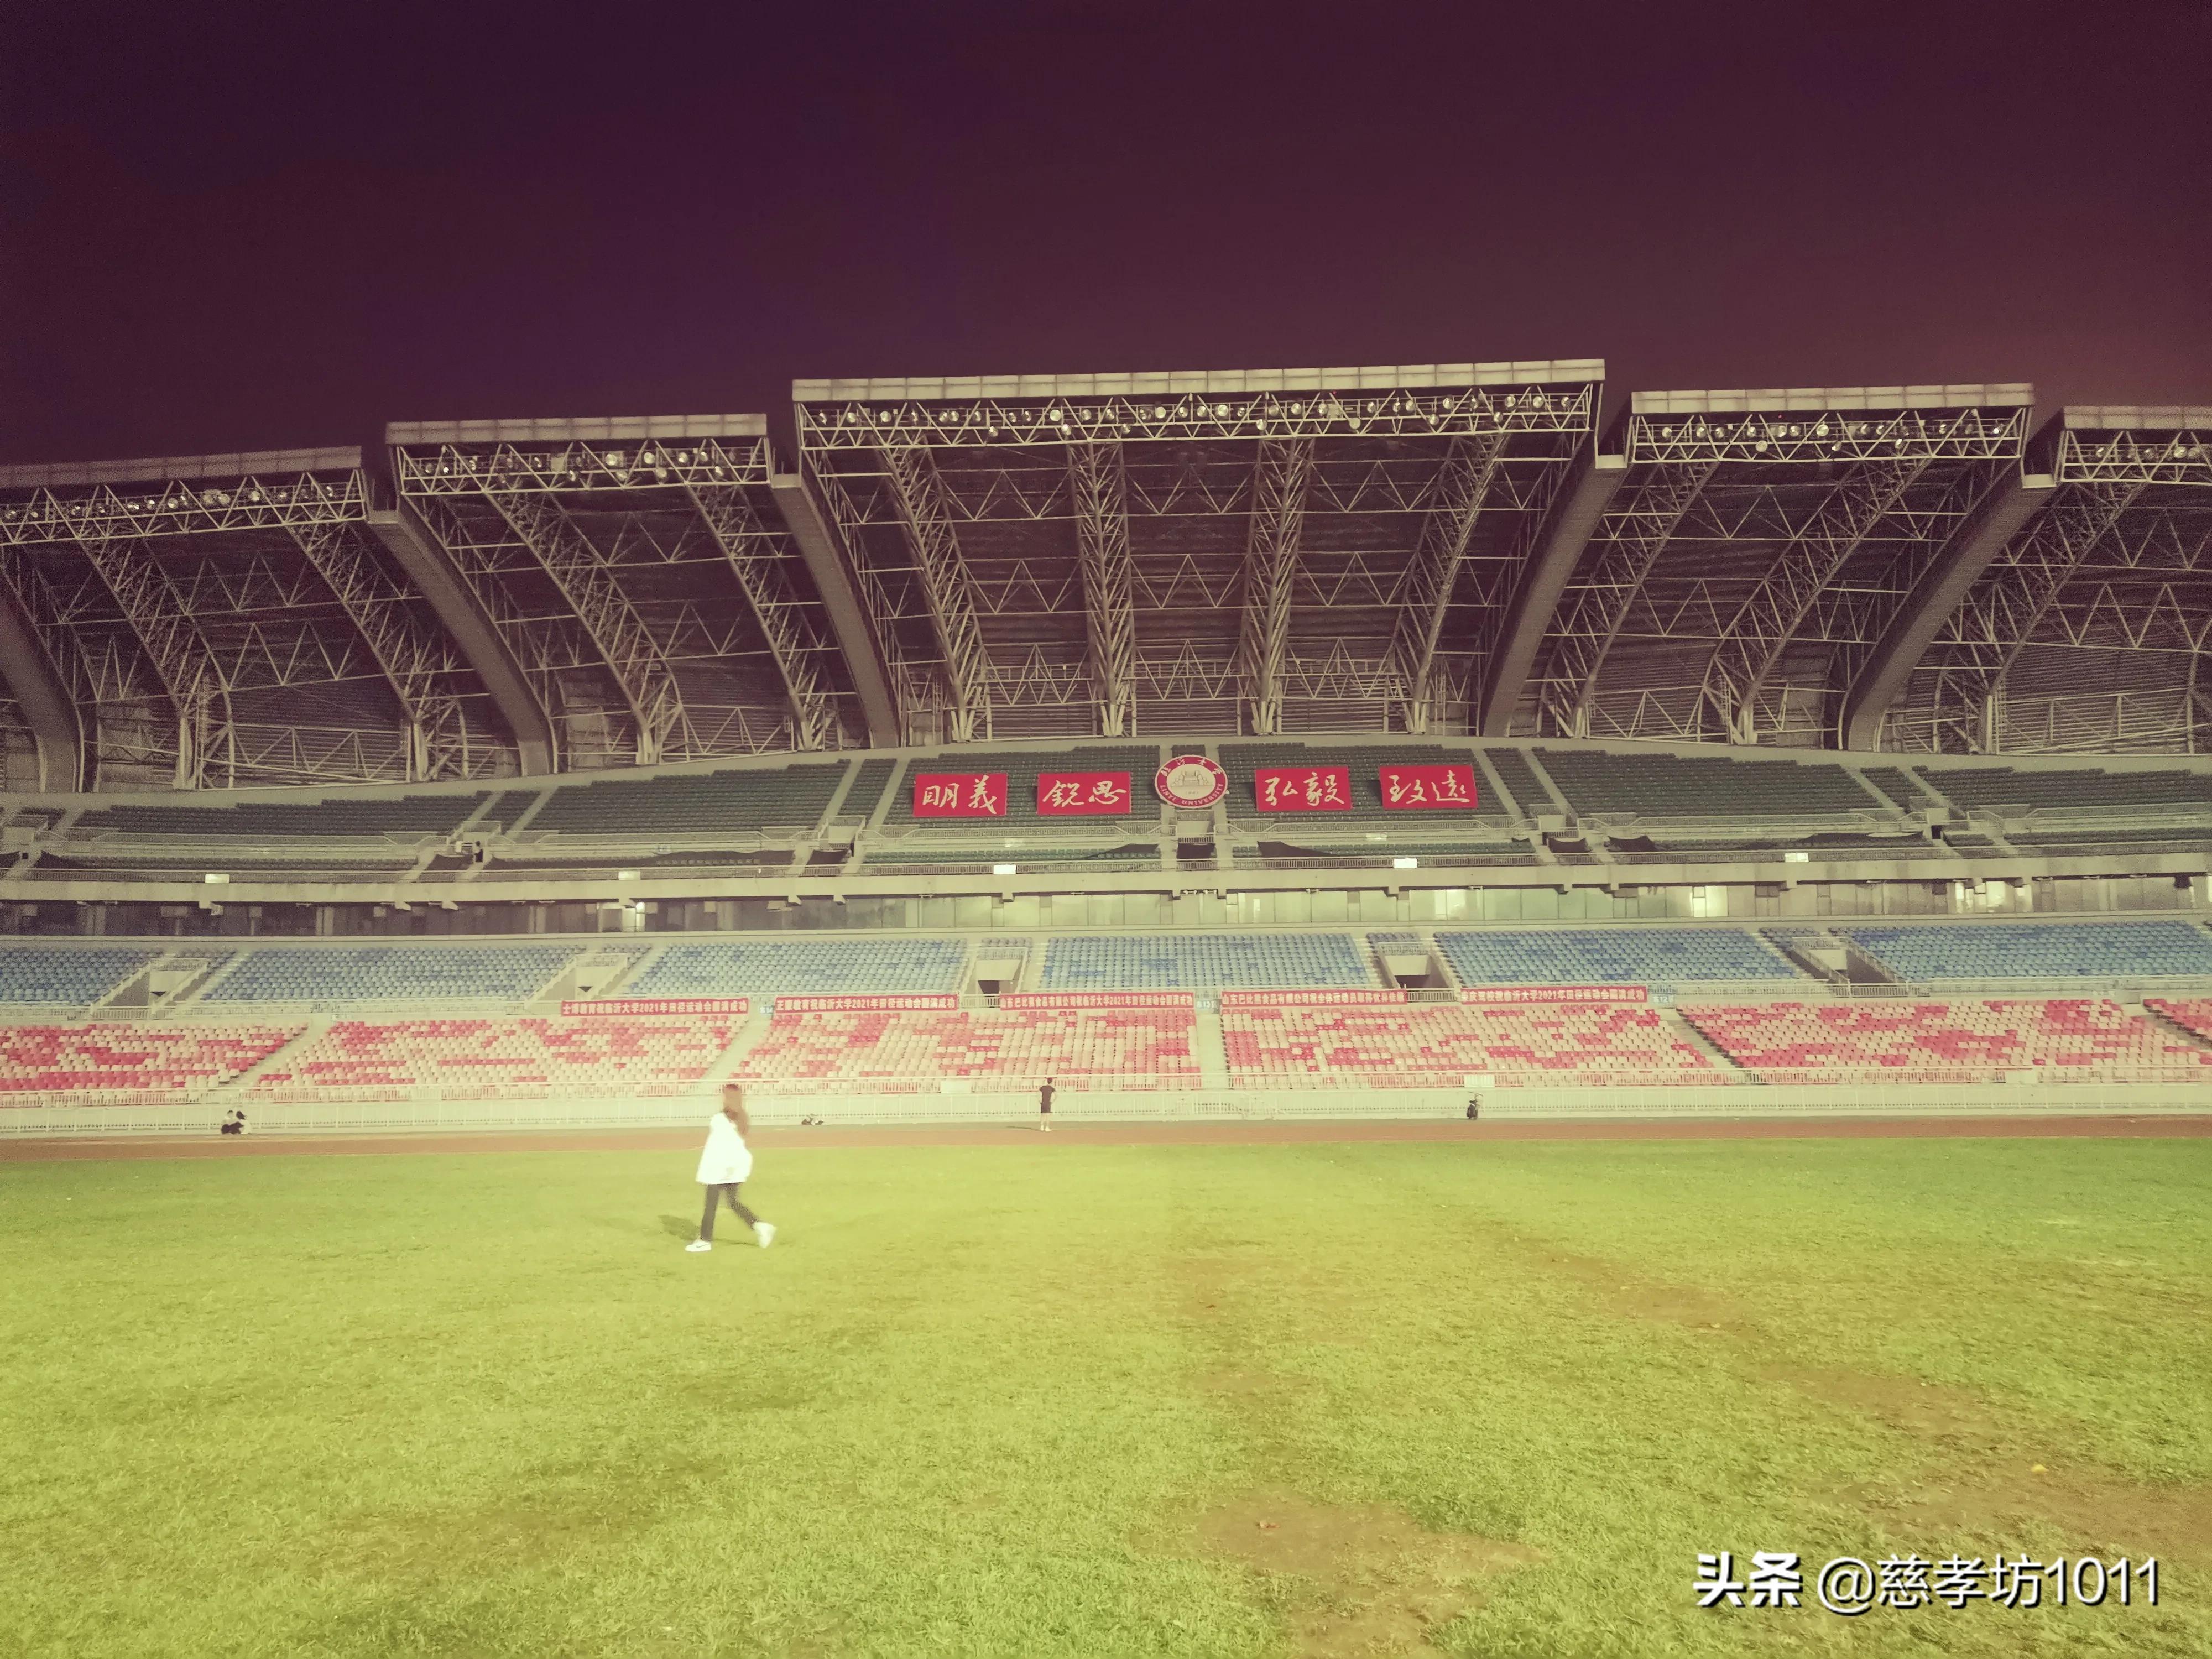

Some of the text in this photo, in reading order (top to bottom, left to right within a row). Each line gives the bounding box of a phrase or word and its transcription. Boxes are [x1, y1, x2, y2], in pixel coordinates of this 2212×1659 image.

[922, 775, 997, 814] 明義
[1160, 782, 1224, 806] LINYI UNIVERSITY
